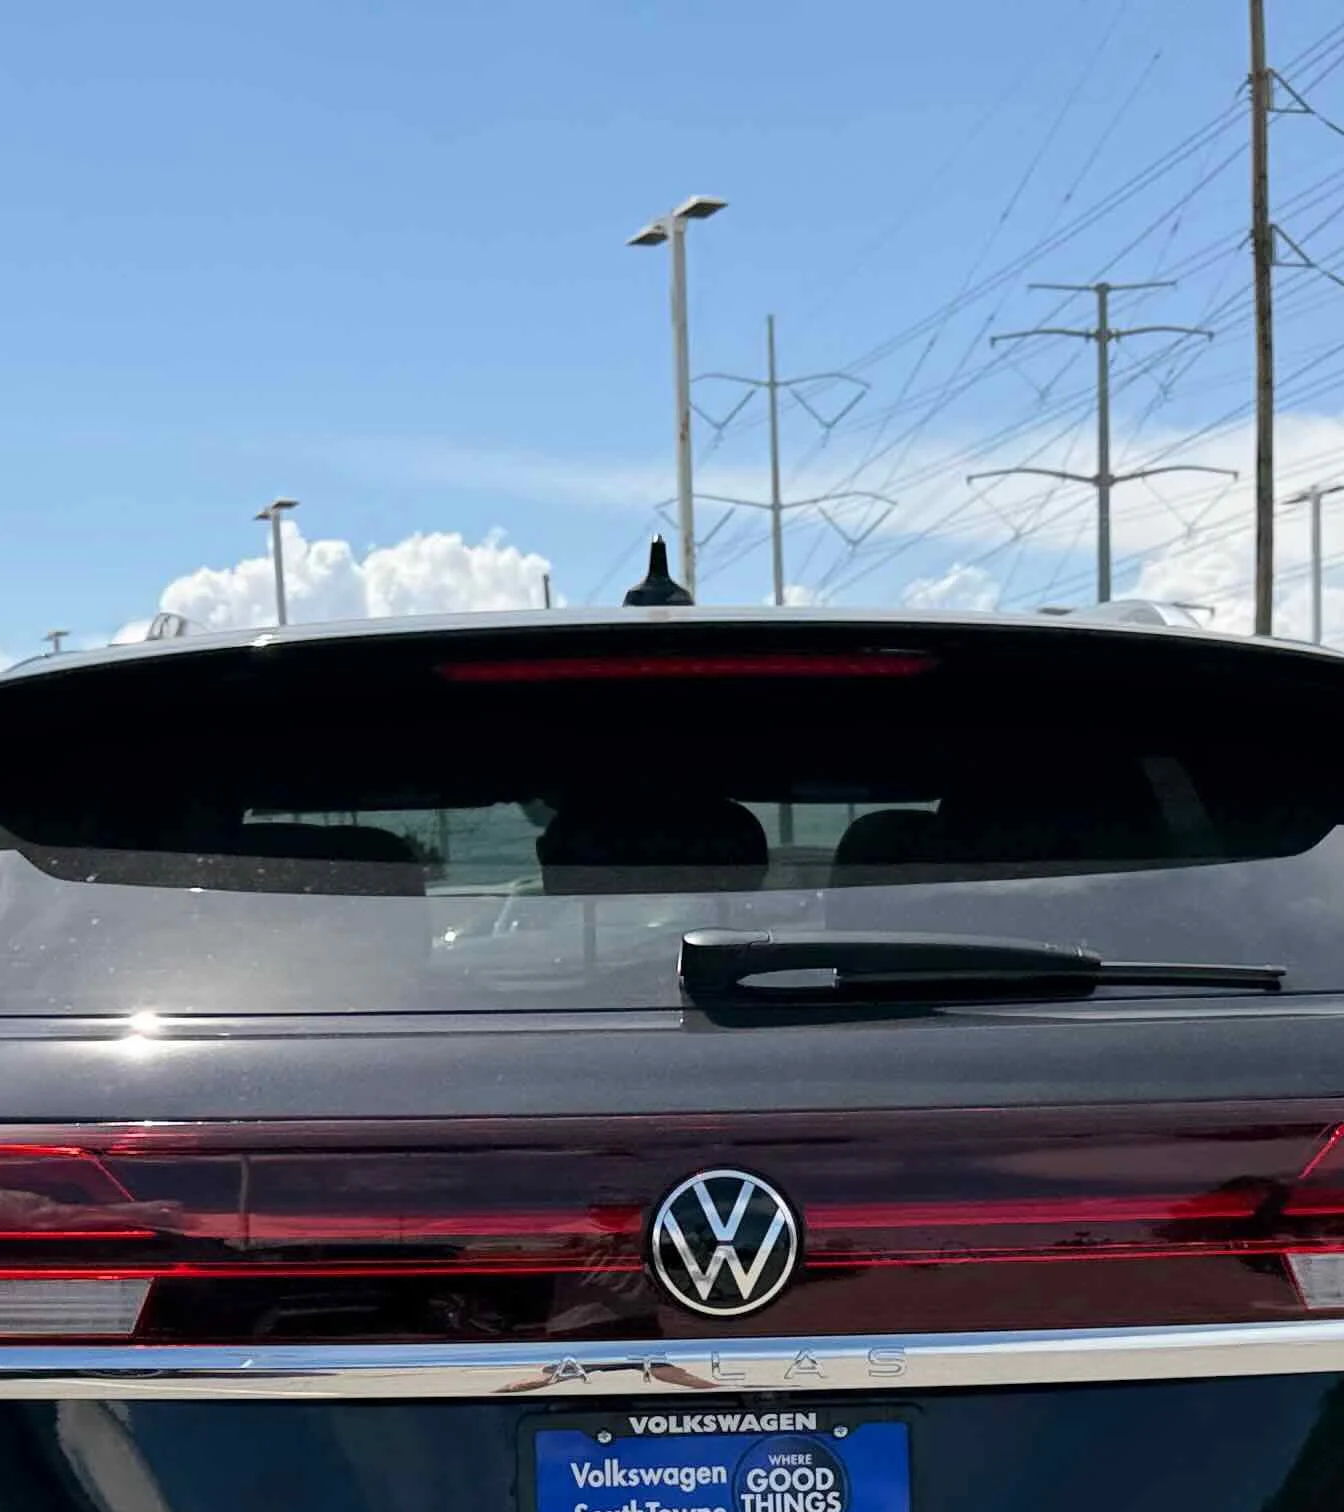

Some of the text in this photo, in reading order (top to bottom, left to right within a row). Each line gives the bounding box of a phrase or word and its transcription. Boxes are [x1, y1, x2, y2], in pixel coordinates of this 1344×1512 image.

[550, 1345, 907, 1385] ATLAS
[628, 1412, 817, 1435] VOLKSWAGEN
[767, 1453, 813, 1466] WHERE
[570, 1459, 728, 1492] Volkswagen
[746, 1467, 835, 1493] GOOD
